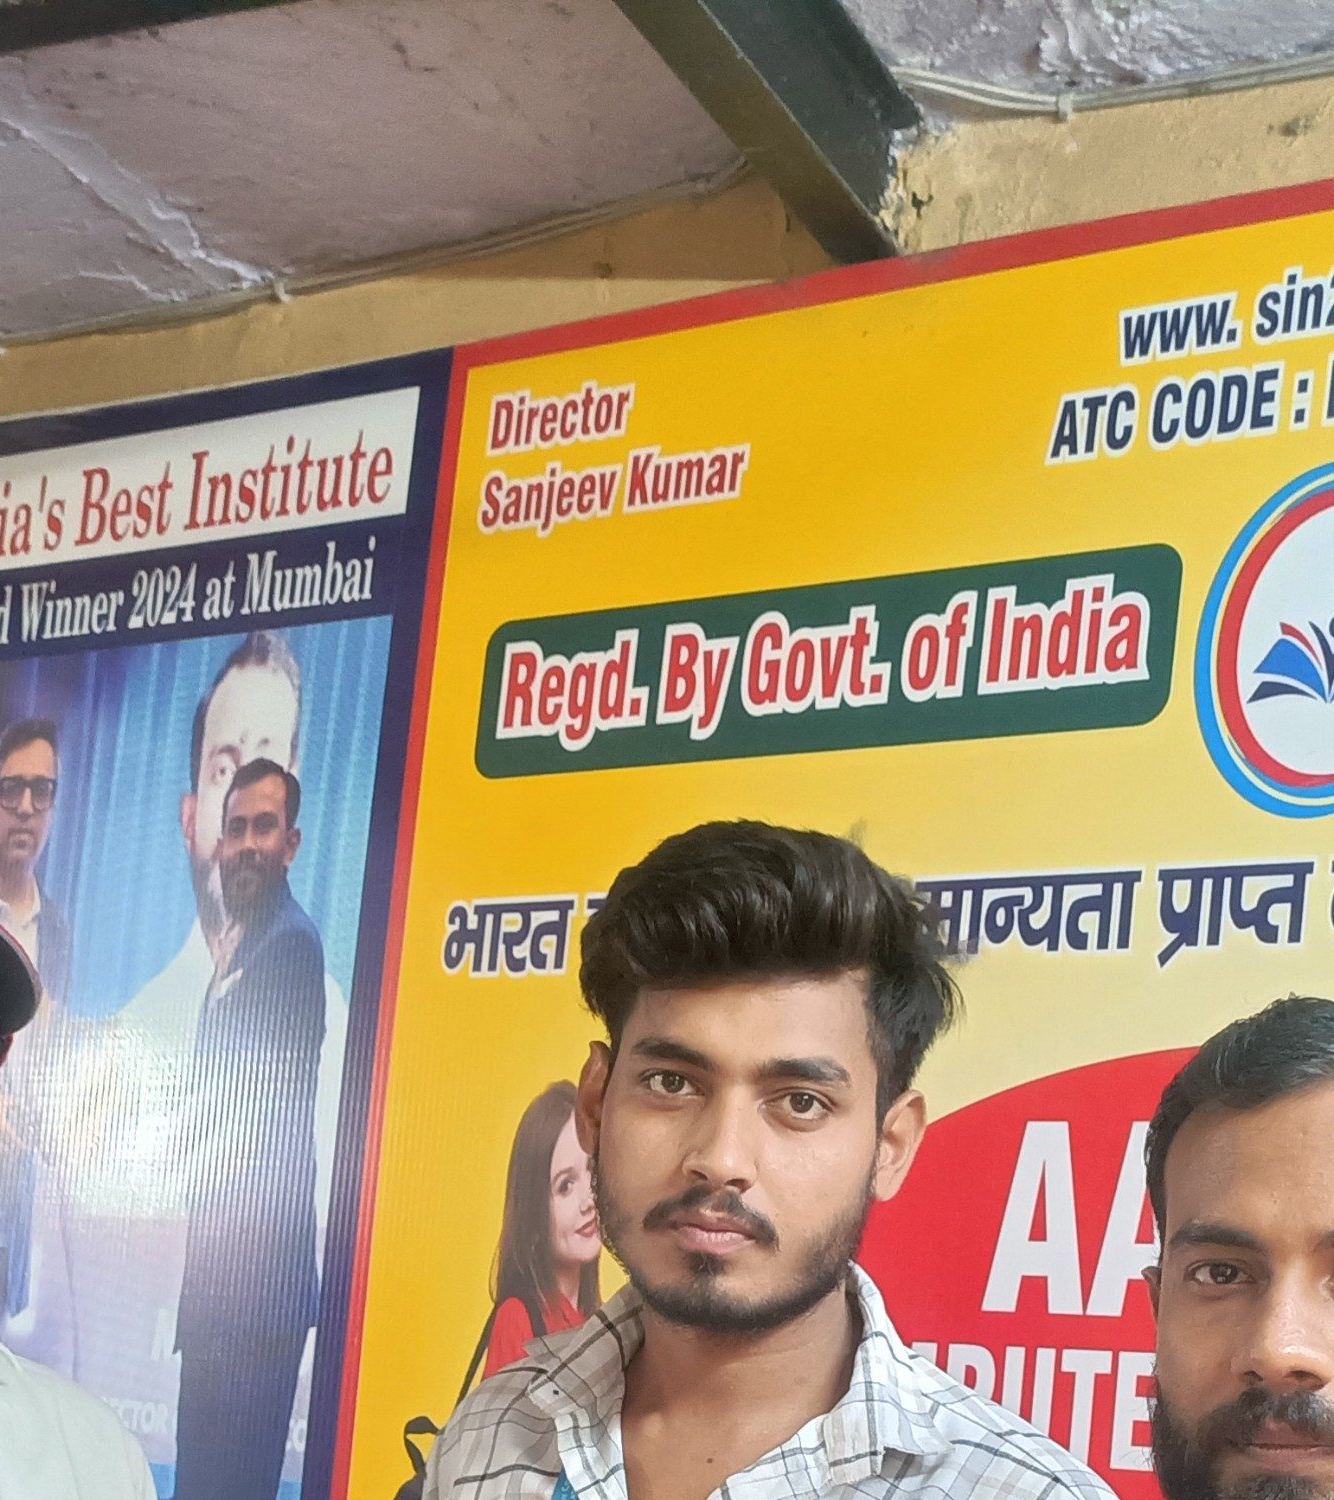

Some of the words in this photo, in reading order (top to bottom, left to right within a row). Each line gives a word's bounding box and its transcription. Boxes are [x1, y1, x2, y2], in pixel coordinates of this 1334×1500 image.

[1124, 300, 1237, 359] www.
[492, 384, 631, 449] Director
[1051, 396, 1133, 458] ATC
[1151, 370, 1279, 439] CODE
[1293, 377, 1307, 423] :
[74, 462, 174, 546] Best
[185, 429, 394, 531] Institute
[481, 464, 617, 531] Sanjeev
[627, 447, 747, 505] Kumar
[19, 578, 125, 641] Winner
[128, 564, 196, 631] 2024
[205, 575, 236, 617] at
[241, 535, 377, 614] Mumbai
[501, 633, 643, 742] Regd.
[666, 625, 736, 735] By
[749, 605, 886, 702] Govt.
[908, 599, 972, 692] of
[986, 577, 1144, 681] India
[443, 899, 574, 973] भारत
[1159, 862, 1314, 969] प्राप्त
